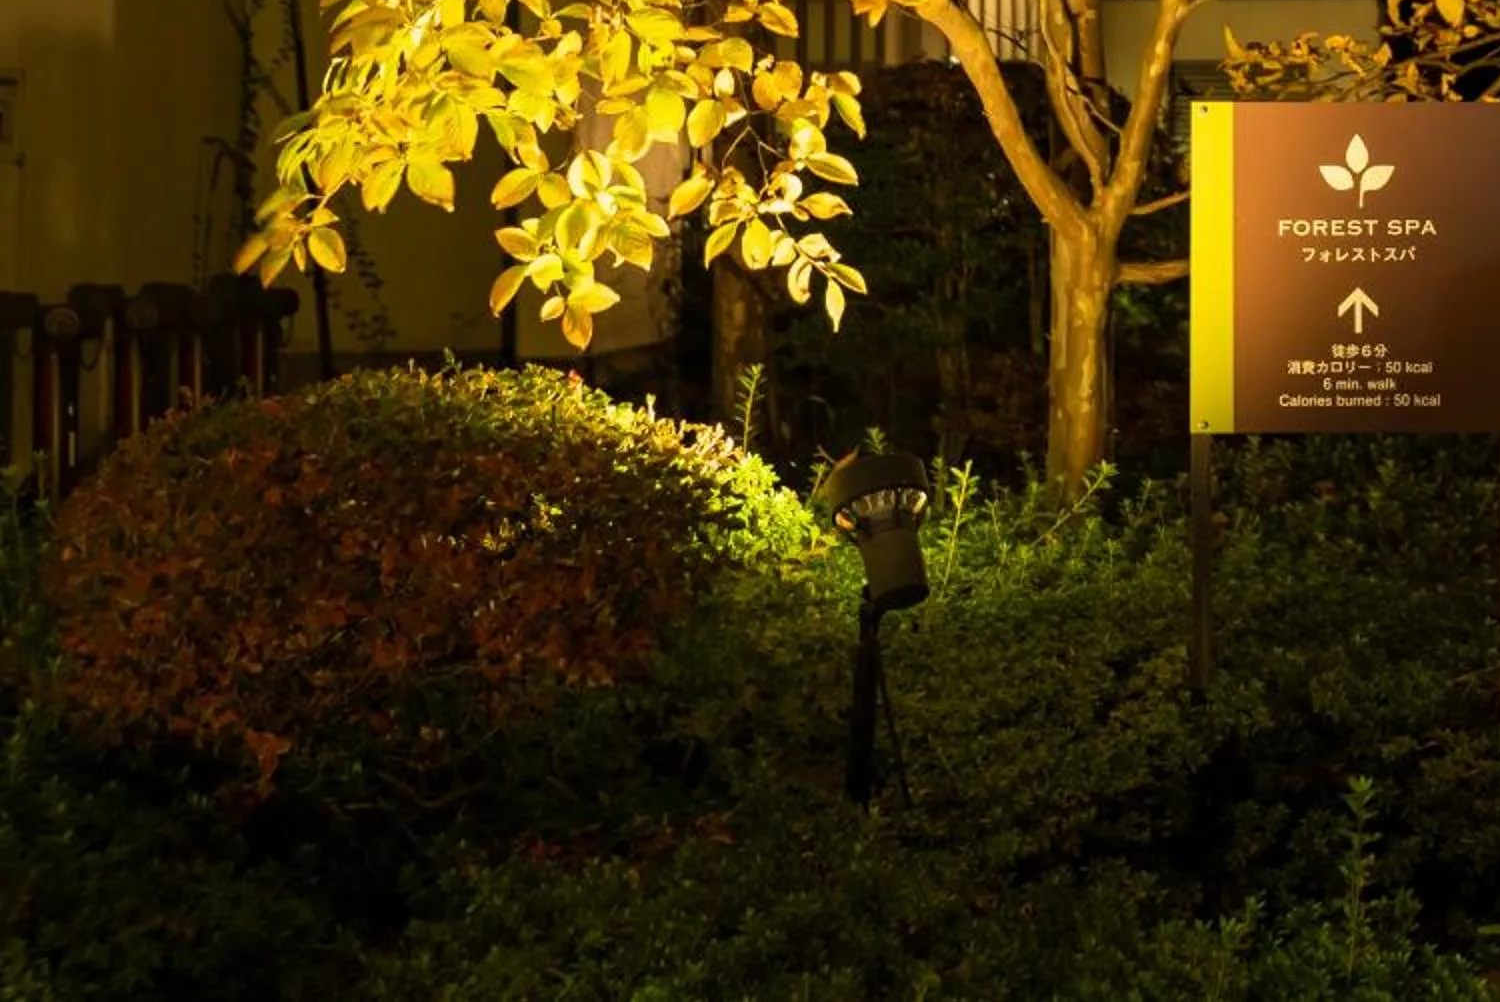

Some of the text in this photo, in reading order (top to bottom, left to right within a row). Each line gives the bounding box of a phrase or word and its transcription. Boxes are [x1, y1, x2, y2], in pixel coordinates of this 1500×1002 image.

[1278, 219, 1437, 236] FOREST SPA
[1302, 246, 1417, 263] フォレストスパ
[1385, 361, 1402, 373] 50
[1405, 361, 1433, 374] kcal
[1323, 378, 1396, 391] 6 min. walk
[1279, 394, 1333, 407] Calories
[1336, 394, 1381, 407] burned
[1393, 394, 1411, 407] 50
[1413, 394, 1441, 407] kcal
